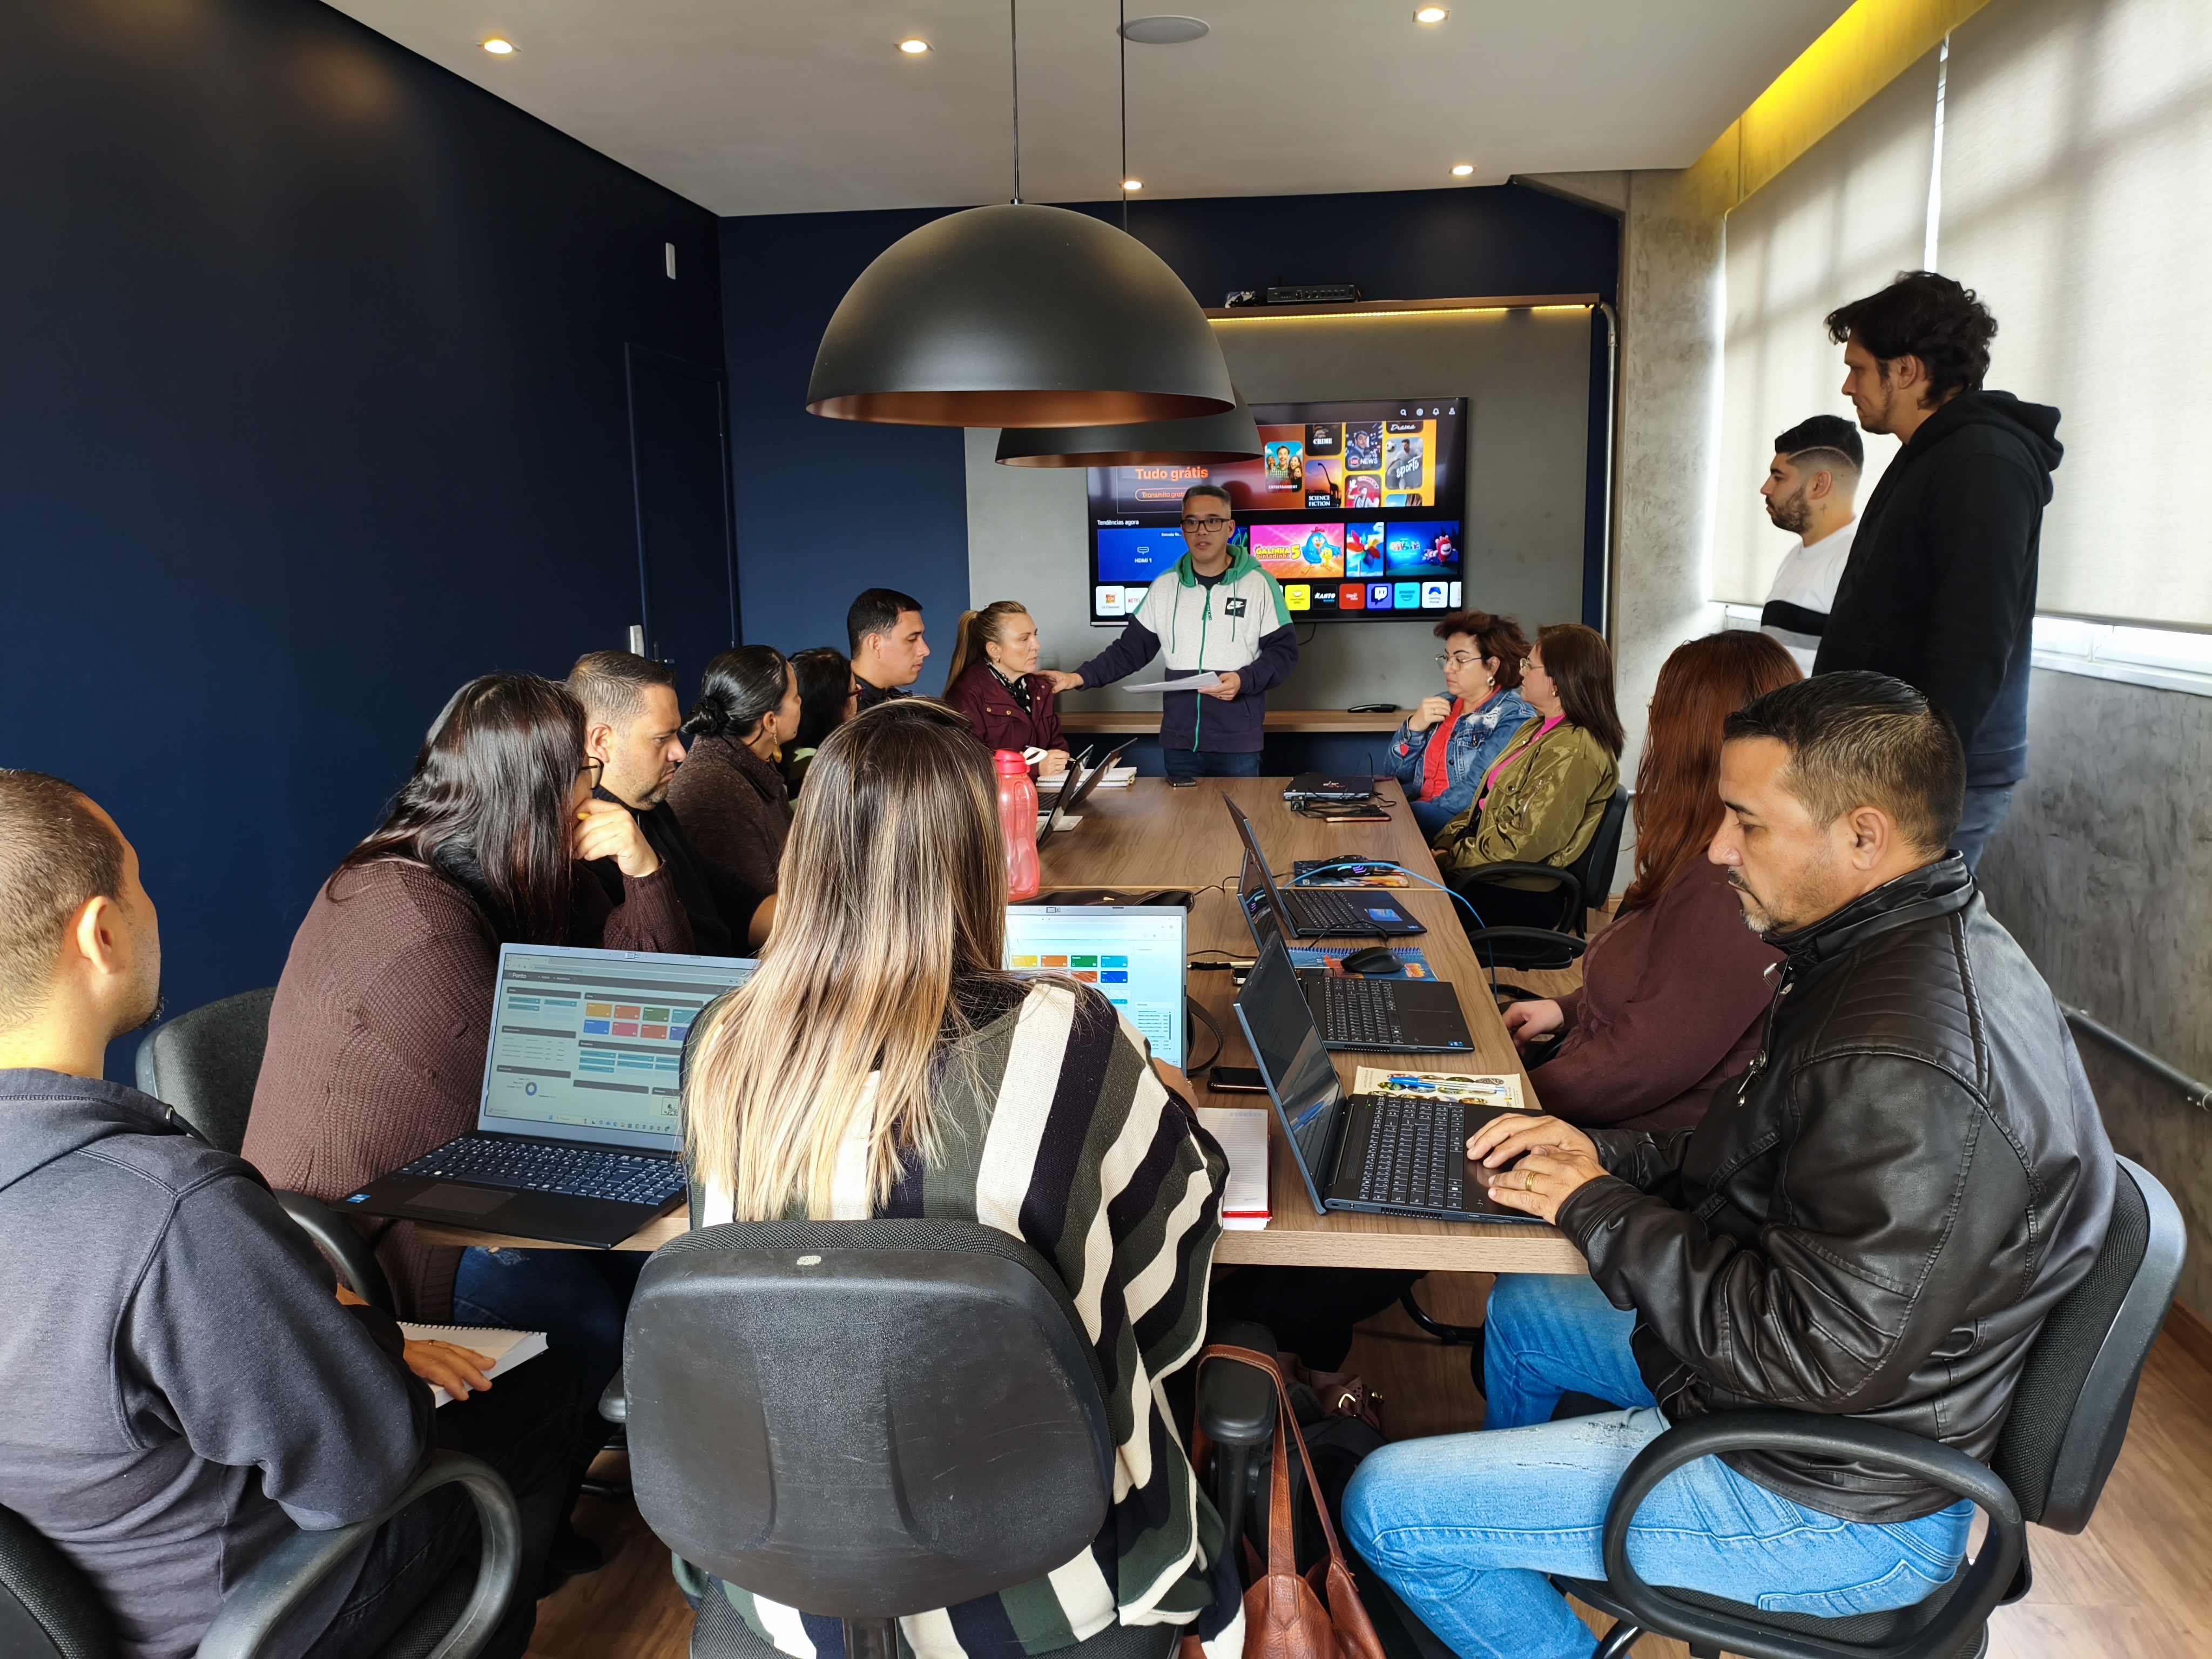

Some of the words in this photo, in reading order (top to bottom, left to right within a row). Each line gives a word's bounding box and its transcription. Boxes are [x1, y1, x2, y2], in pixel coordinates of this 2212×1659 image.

[1135, 468, 1168, 480] Tudo
[1170, 466, 1209, 482] grátis
[1290, 544, 1301, 560] 5
